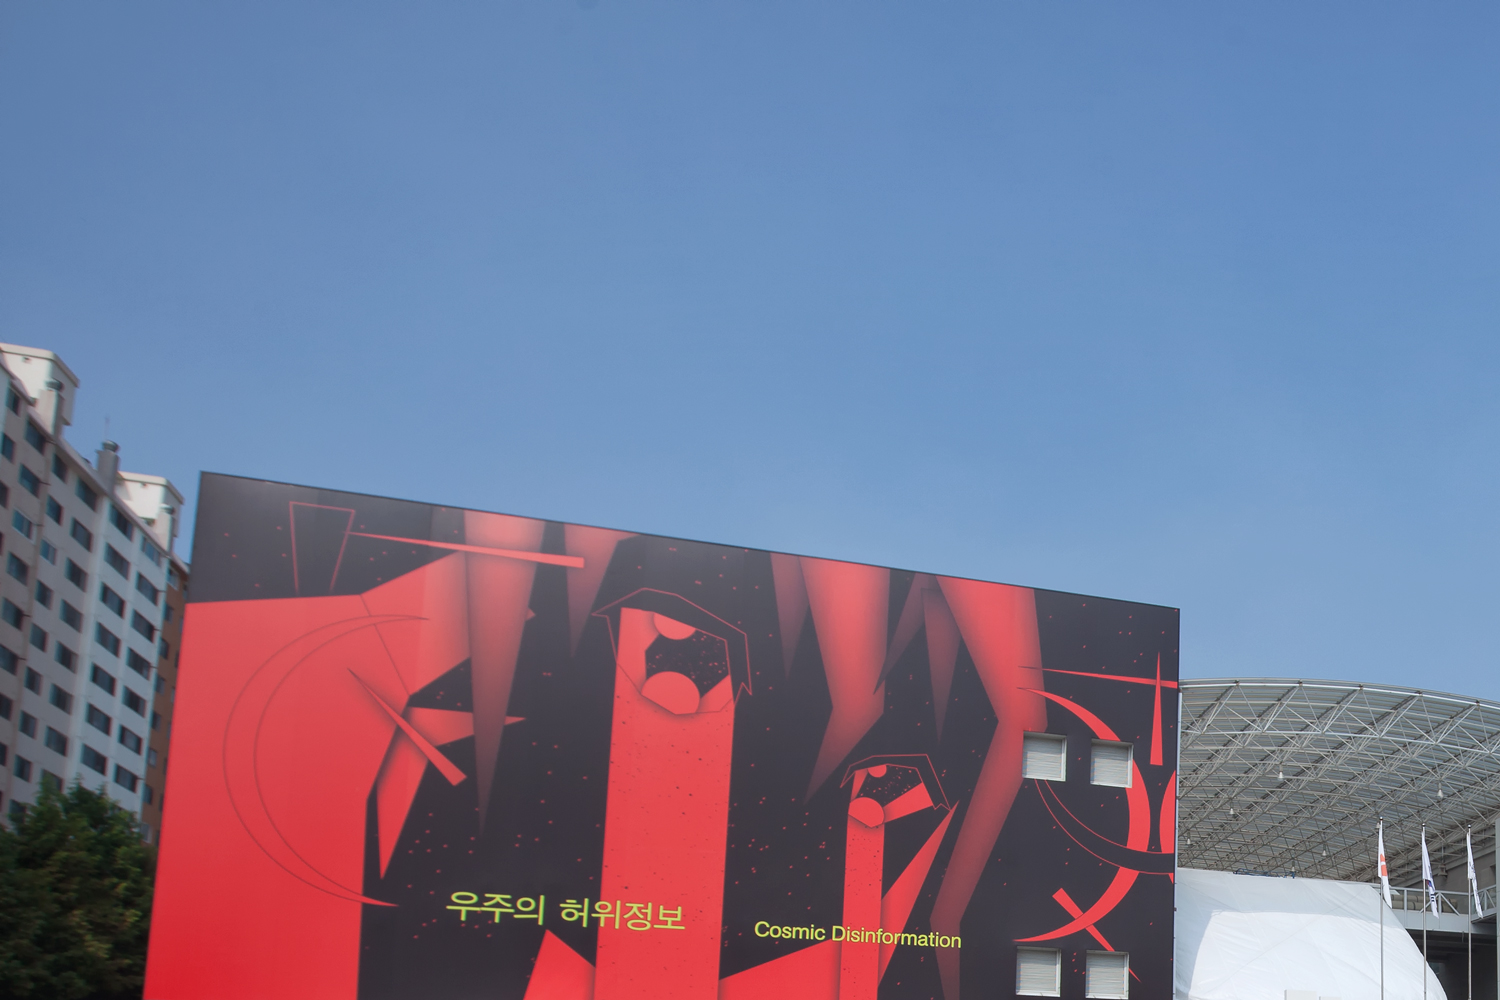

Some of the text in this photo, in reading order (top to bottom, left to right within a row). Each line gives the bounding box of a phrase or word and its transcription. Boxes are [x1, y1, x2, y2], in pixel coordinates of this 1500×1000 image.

[446, 891, 686, 931] 우주의 허위정보
[754, 921, 962, 949] Cosmic Disinformation
